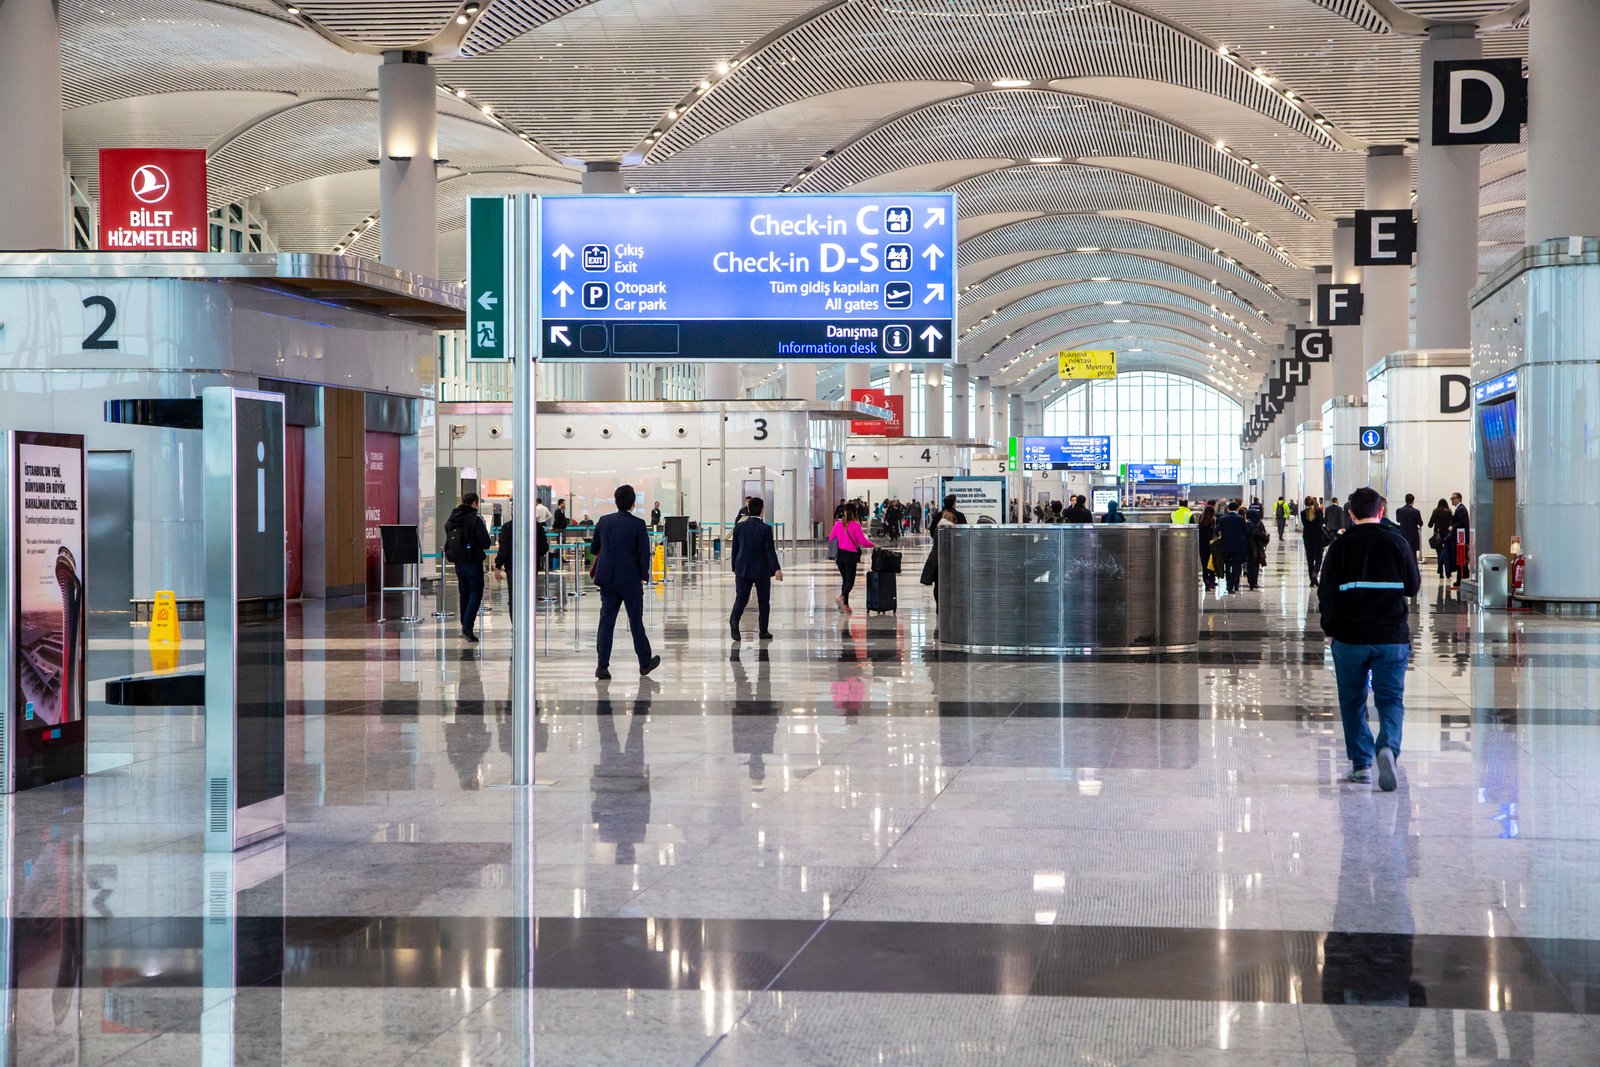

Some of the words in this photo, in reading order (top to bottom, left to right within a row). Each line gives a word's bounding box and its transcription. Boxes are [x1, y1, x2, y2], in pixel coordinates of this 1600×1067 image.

[1448, 69, 1505, 134] D
[129, 207, 173, 227] BİLET
[750, 214, 847, 236] Check-in
[856, 205, 879, 235] C
[108, 227, 198, 247] HİZMETLERİ
[1370, 216, 1397, 259] E
[614, 243, 645, 259] Çıkış
[713, 252, 809, 273] Check-in
[820, 243, 879, 273] D-S
[614, 261, 638, 273] Exit
[590, 286, 603, 305] P
[614, 281, 667, 296] Otopark
[769, 280, 797, 293] Tüm
[800, 280, 830, 296] gidiş
[833, 280, 879, 296] kapıları
[614, 298, 637, 310] Car
[638, 298, 667, 313] park
[825, 298, 842, 310] All
[844, 300, 879, 313] gates
[1329, 288, 1349, 321] F
[82, 295, 119, 350] 2
[826, 325, 878, 340] Danışma
[778, 341, 847, 354] Information
[849, 342, 878, 354] desk
[1301, 332, 1324, 358] G
[1110, 352, 1115, 364] 1
[1285, 361, 1303, 383] H
[1276, 385, 1287, 399] J
[1440, 374, 1471, 414] D
[753, 418, 768, 441] 3
[921, 448, 931, 462] 4
[998, 462, 1006, 473] 5
[1042, 471, 1049, 479] 6
